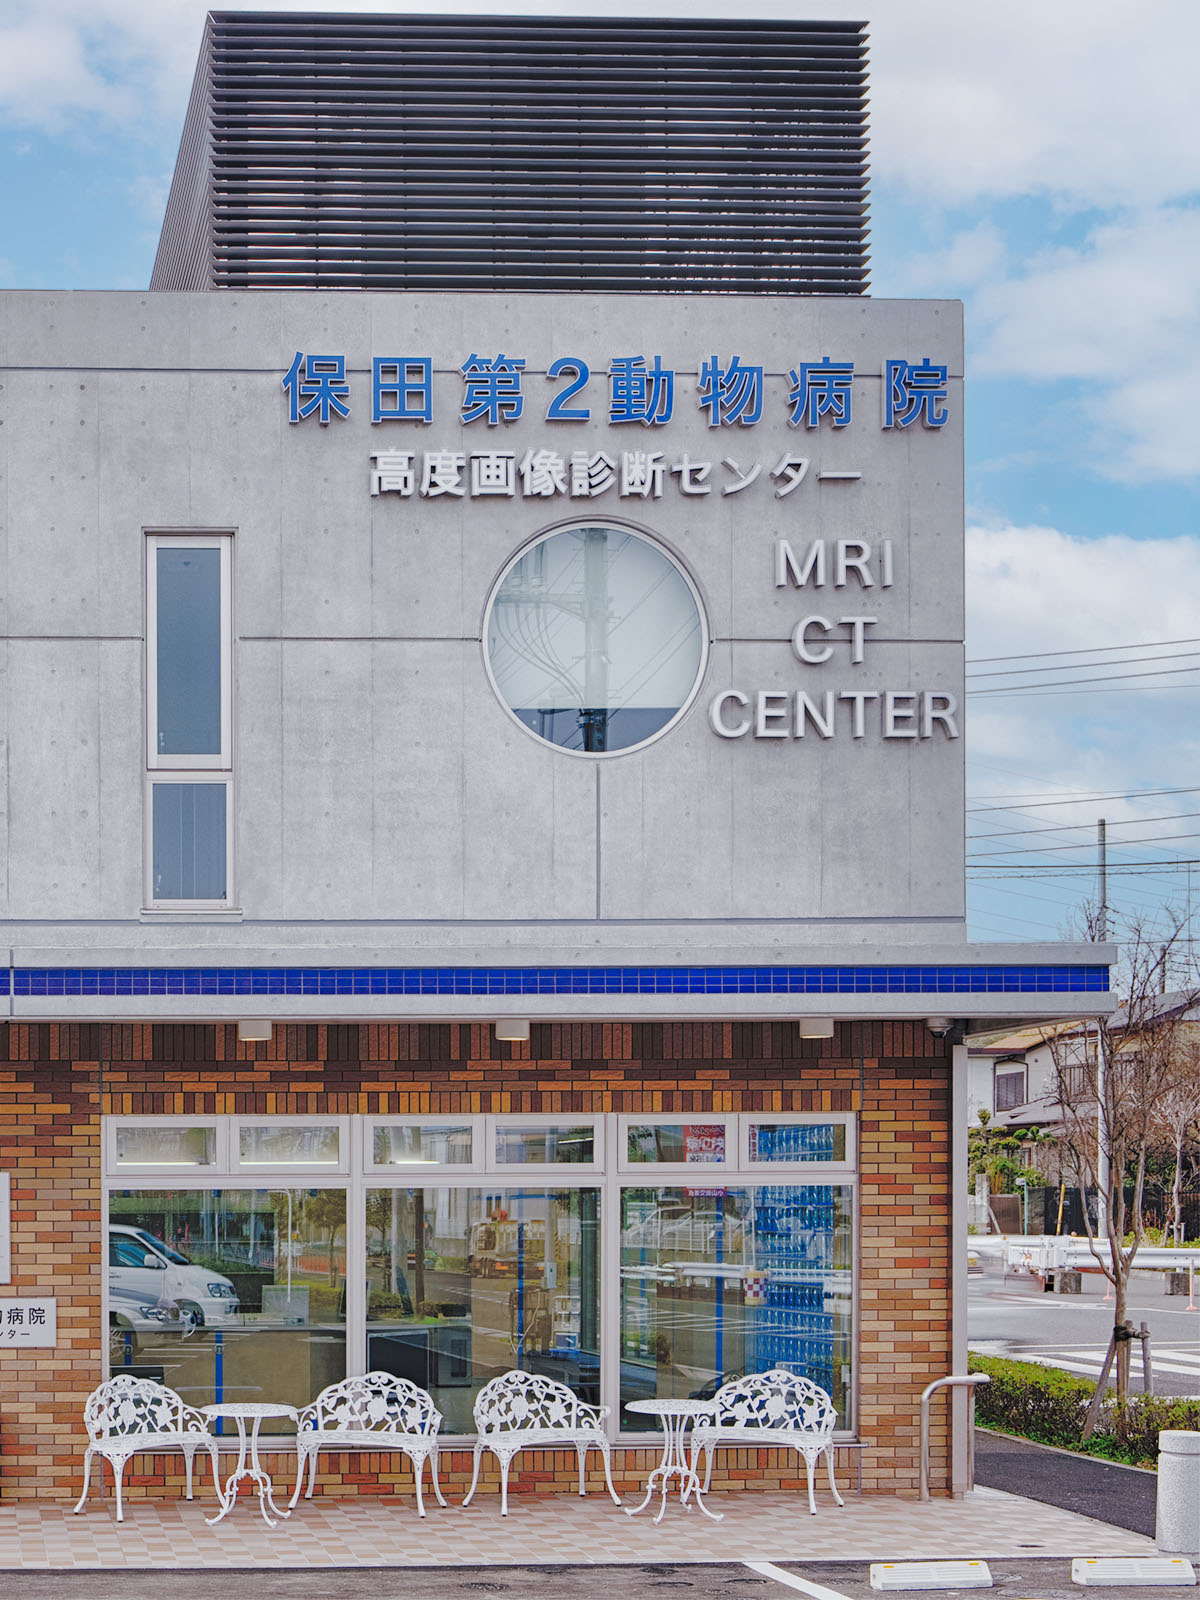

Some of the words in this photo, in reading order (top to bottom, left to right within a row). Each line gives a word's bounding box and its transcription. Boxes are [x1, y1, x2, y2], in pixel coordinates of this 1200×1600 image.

[281, 350, 949, 428] 保田第2動物病院
[369, 449, 861, 498] 高度画像診断センター
[774, 539, 894, 588] MRI
[790, 615, 878, 665] CT
[708, 690, 960, 739] CENTER
